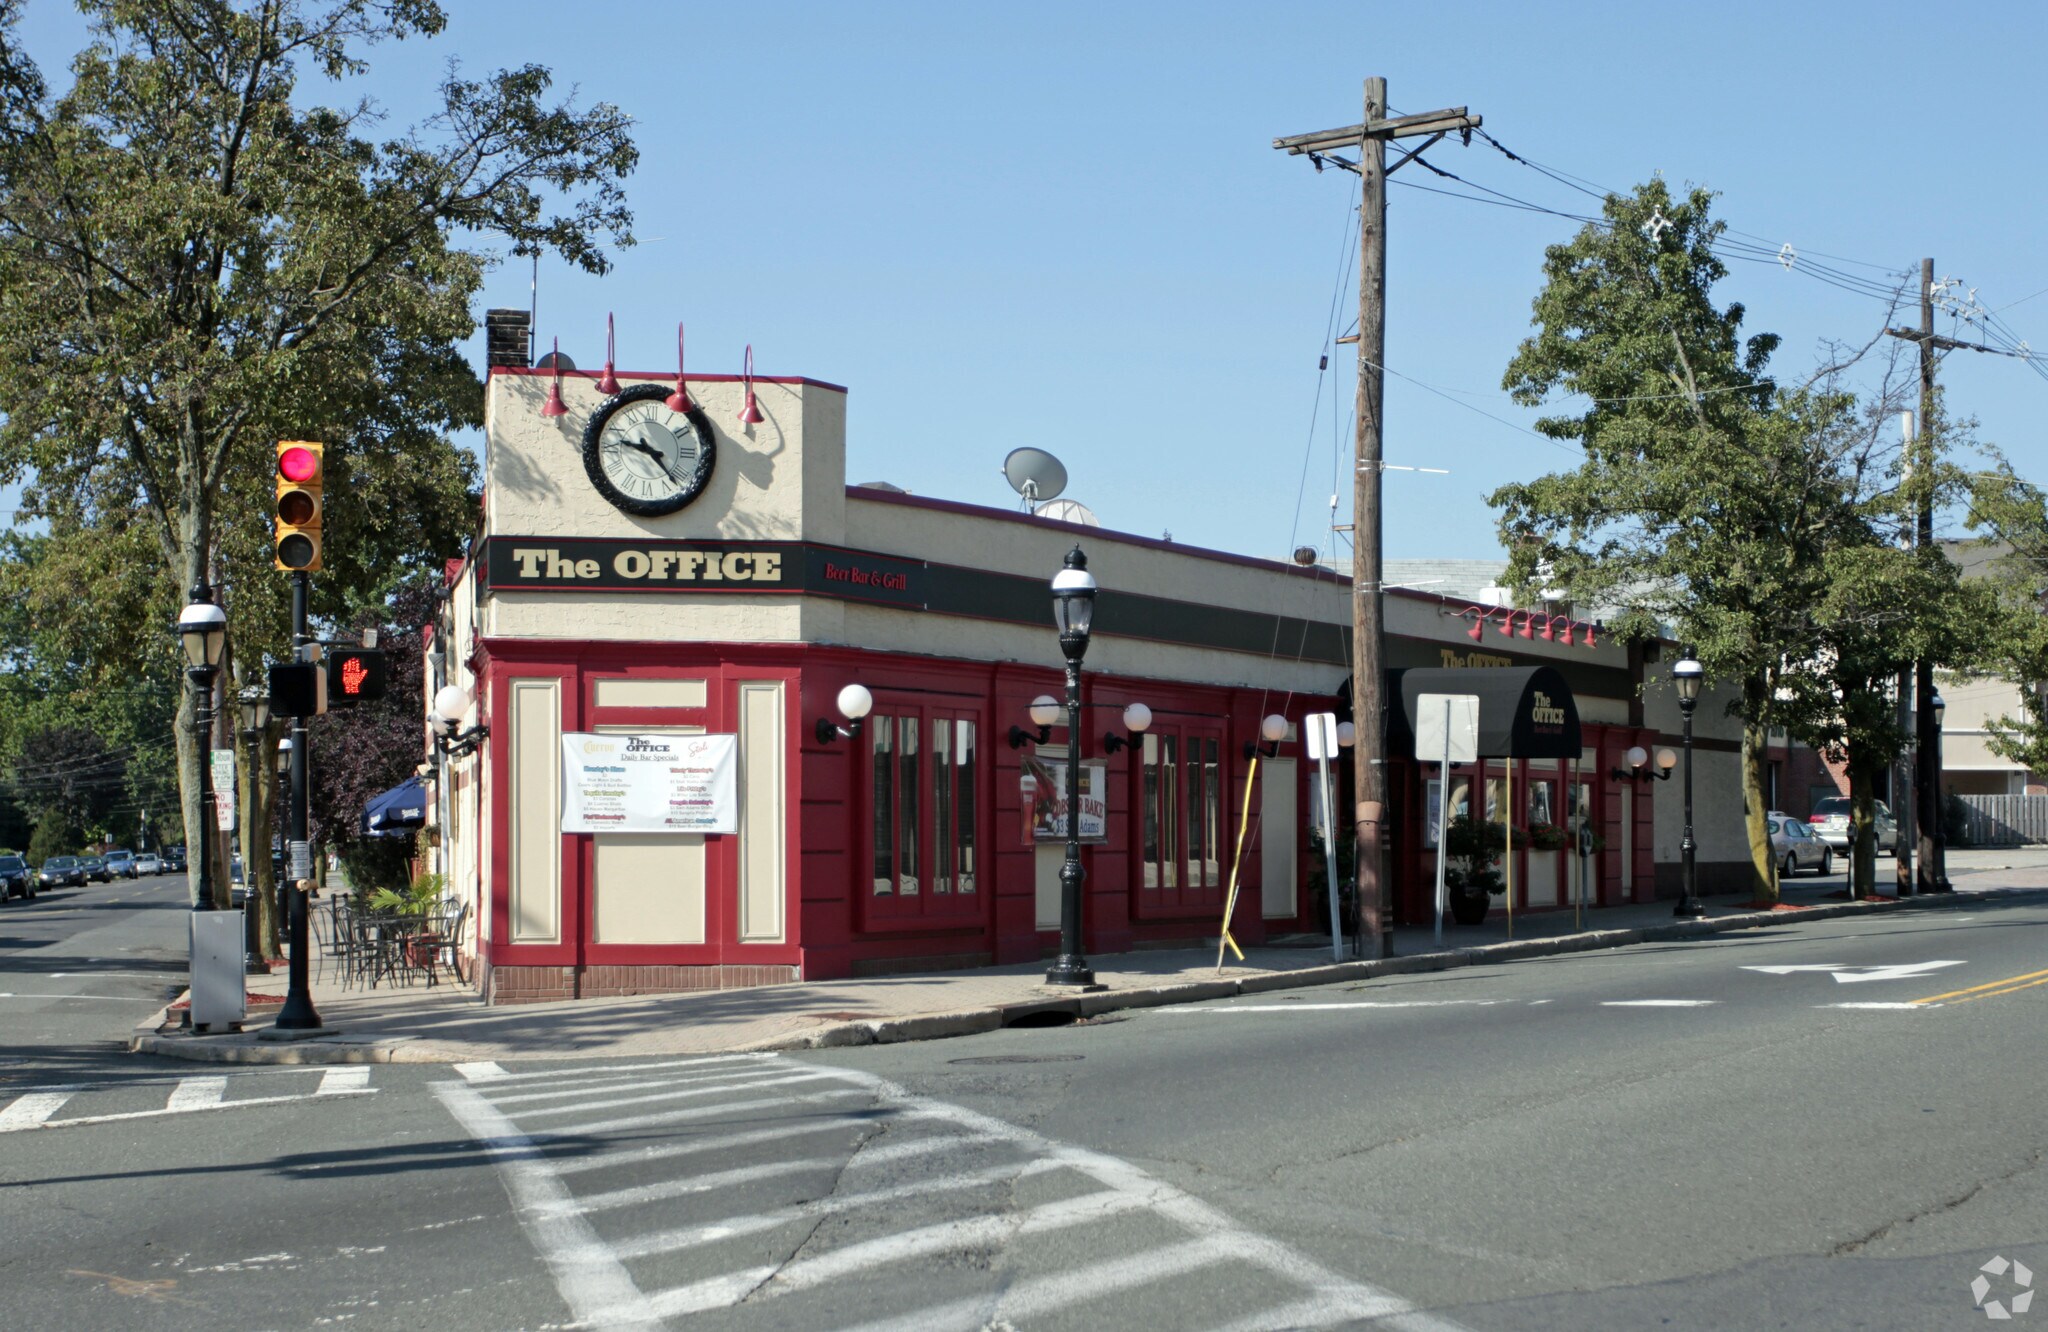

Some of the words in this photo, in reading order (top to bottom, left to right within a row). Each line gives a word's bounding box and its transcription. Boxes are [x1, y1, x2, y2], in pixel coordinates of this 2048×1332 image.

[513, 549, 600, 579] The
[613, 550, 782, 581] OFFICE
[825, 562, 849, 581] Beer
[851, 566, 869, 584] Bar
[870, 570, 881, 587] &
[883, 572, 907, 591] Grill
[1440, 648, 1465, 668] The
[1533, 691, 1551, 708] The
[1531, 707, 1565, 725] OFFICE
[628, 737, 650, 745] The
[621, 753, 638, 762] Daily
[640, 753, 652, 761] Bar
[653, 753, 680, 762] Specials
[1084, 798, 1104, 818] BAKE
[1080, 819, 1099, 833] Adams
